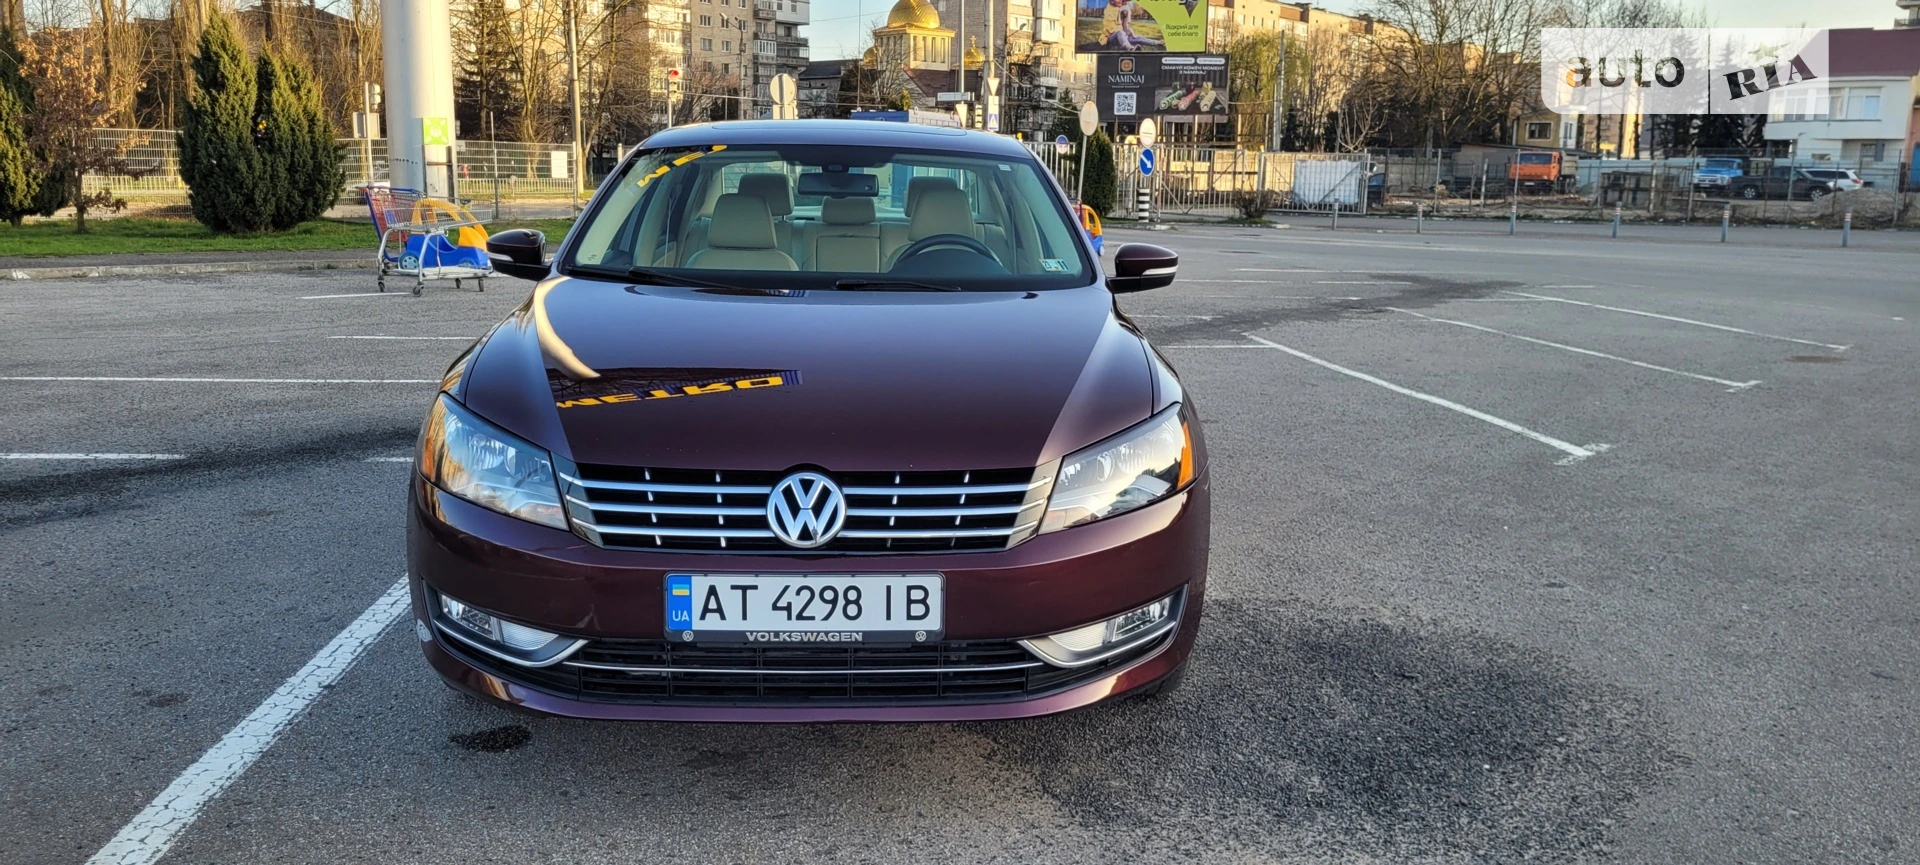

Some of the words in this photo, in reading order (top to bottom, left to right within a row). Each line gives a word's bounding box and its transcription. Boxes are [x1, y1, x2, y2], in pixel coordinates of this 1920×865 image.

[1108, 75, 1145, 84] NAMINAJ
[699, 584, 759, 621] AT
[771, 584, 863, 622] 4298
[885, 584, 931, 621] IB
[672, 610, 690, 622] UA
[746, 632, 863, 642] VOLKSWAGEN
